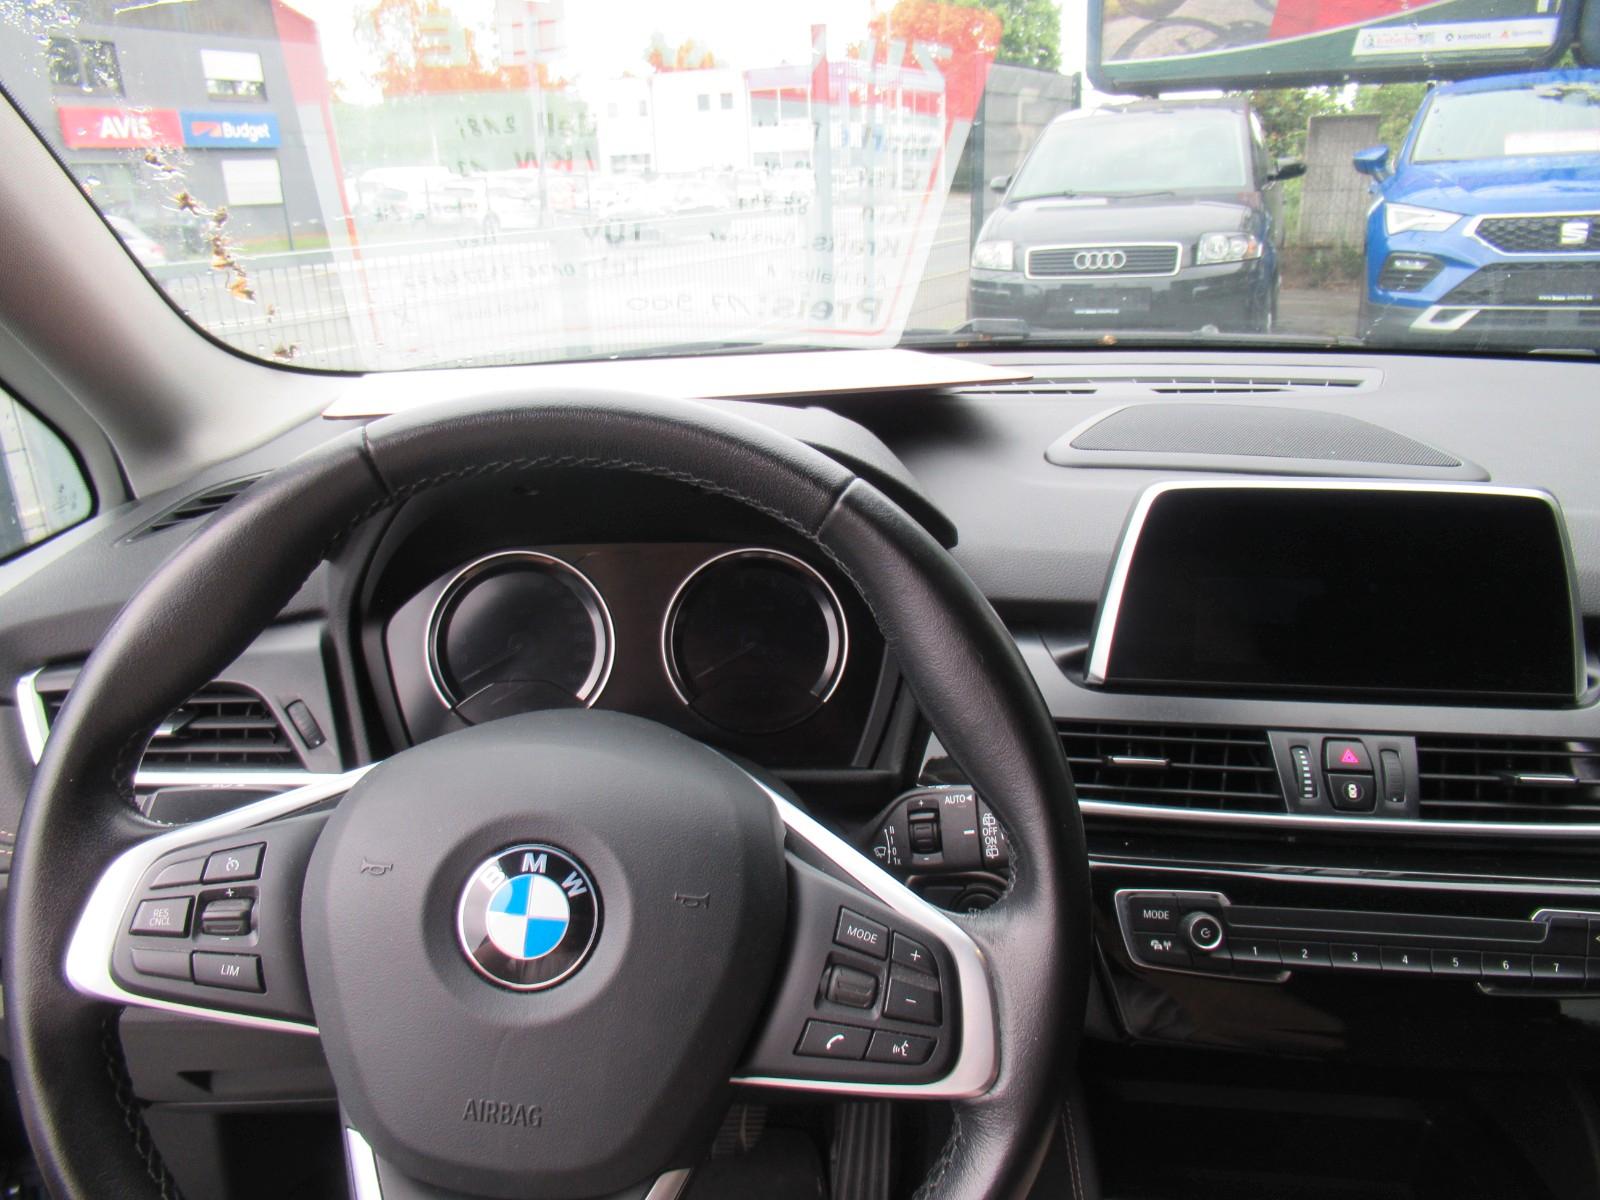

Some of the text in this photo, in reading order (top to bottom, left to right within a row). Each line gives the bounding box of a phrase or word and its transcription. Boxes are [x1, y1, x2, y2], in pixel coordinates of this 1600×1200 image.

[100, 116, 153, 140] AVIS
[222, 122, 271, 143] Budget
[944, 794, 966, 805] AUTO
[982, 827, 998, 837] OFF
[984, 836, 998, 845] ON
[480, 852, 588, 898] BMW
[153, 908, 169, 918] RES
[1143, 909, 1170, 920] MODE
[847, 925, 879, 944] MODE
[1252, 946, 1258, 957] 1
[1302, 949, 1308, 959] 2
[1352, 952, 1358, 962] 3
[1402, 955, 1409, 965] 4
[1452, 957, 1459, 968] 5
[1502, 960, 1510, 970] 6
[220, 964, 240, 977] LIM
[1553, 962, 1560, 973] 7
[462, 1098, 543, 1128] AIRBAG
